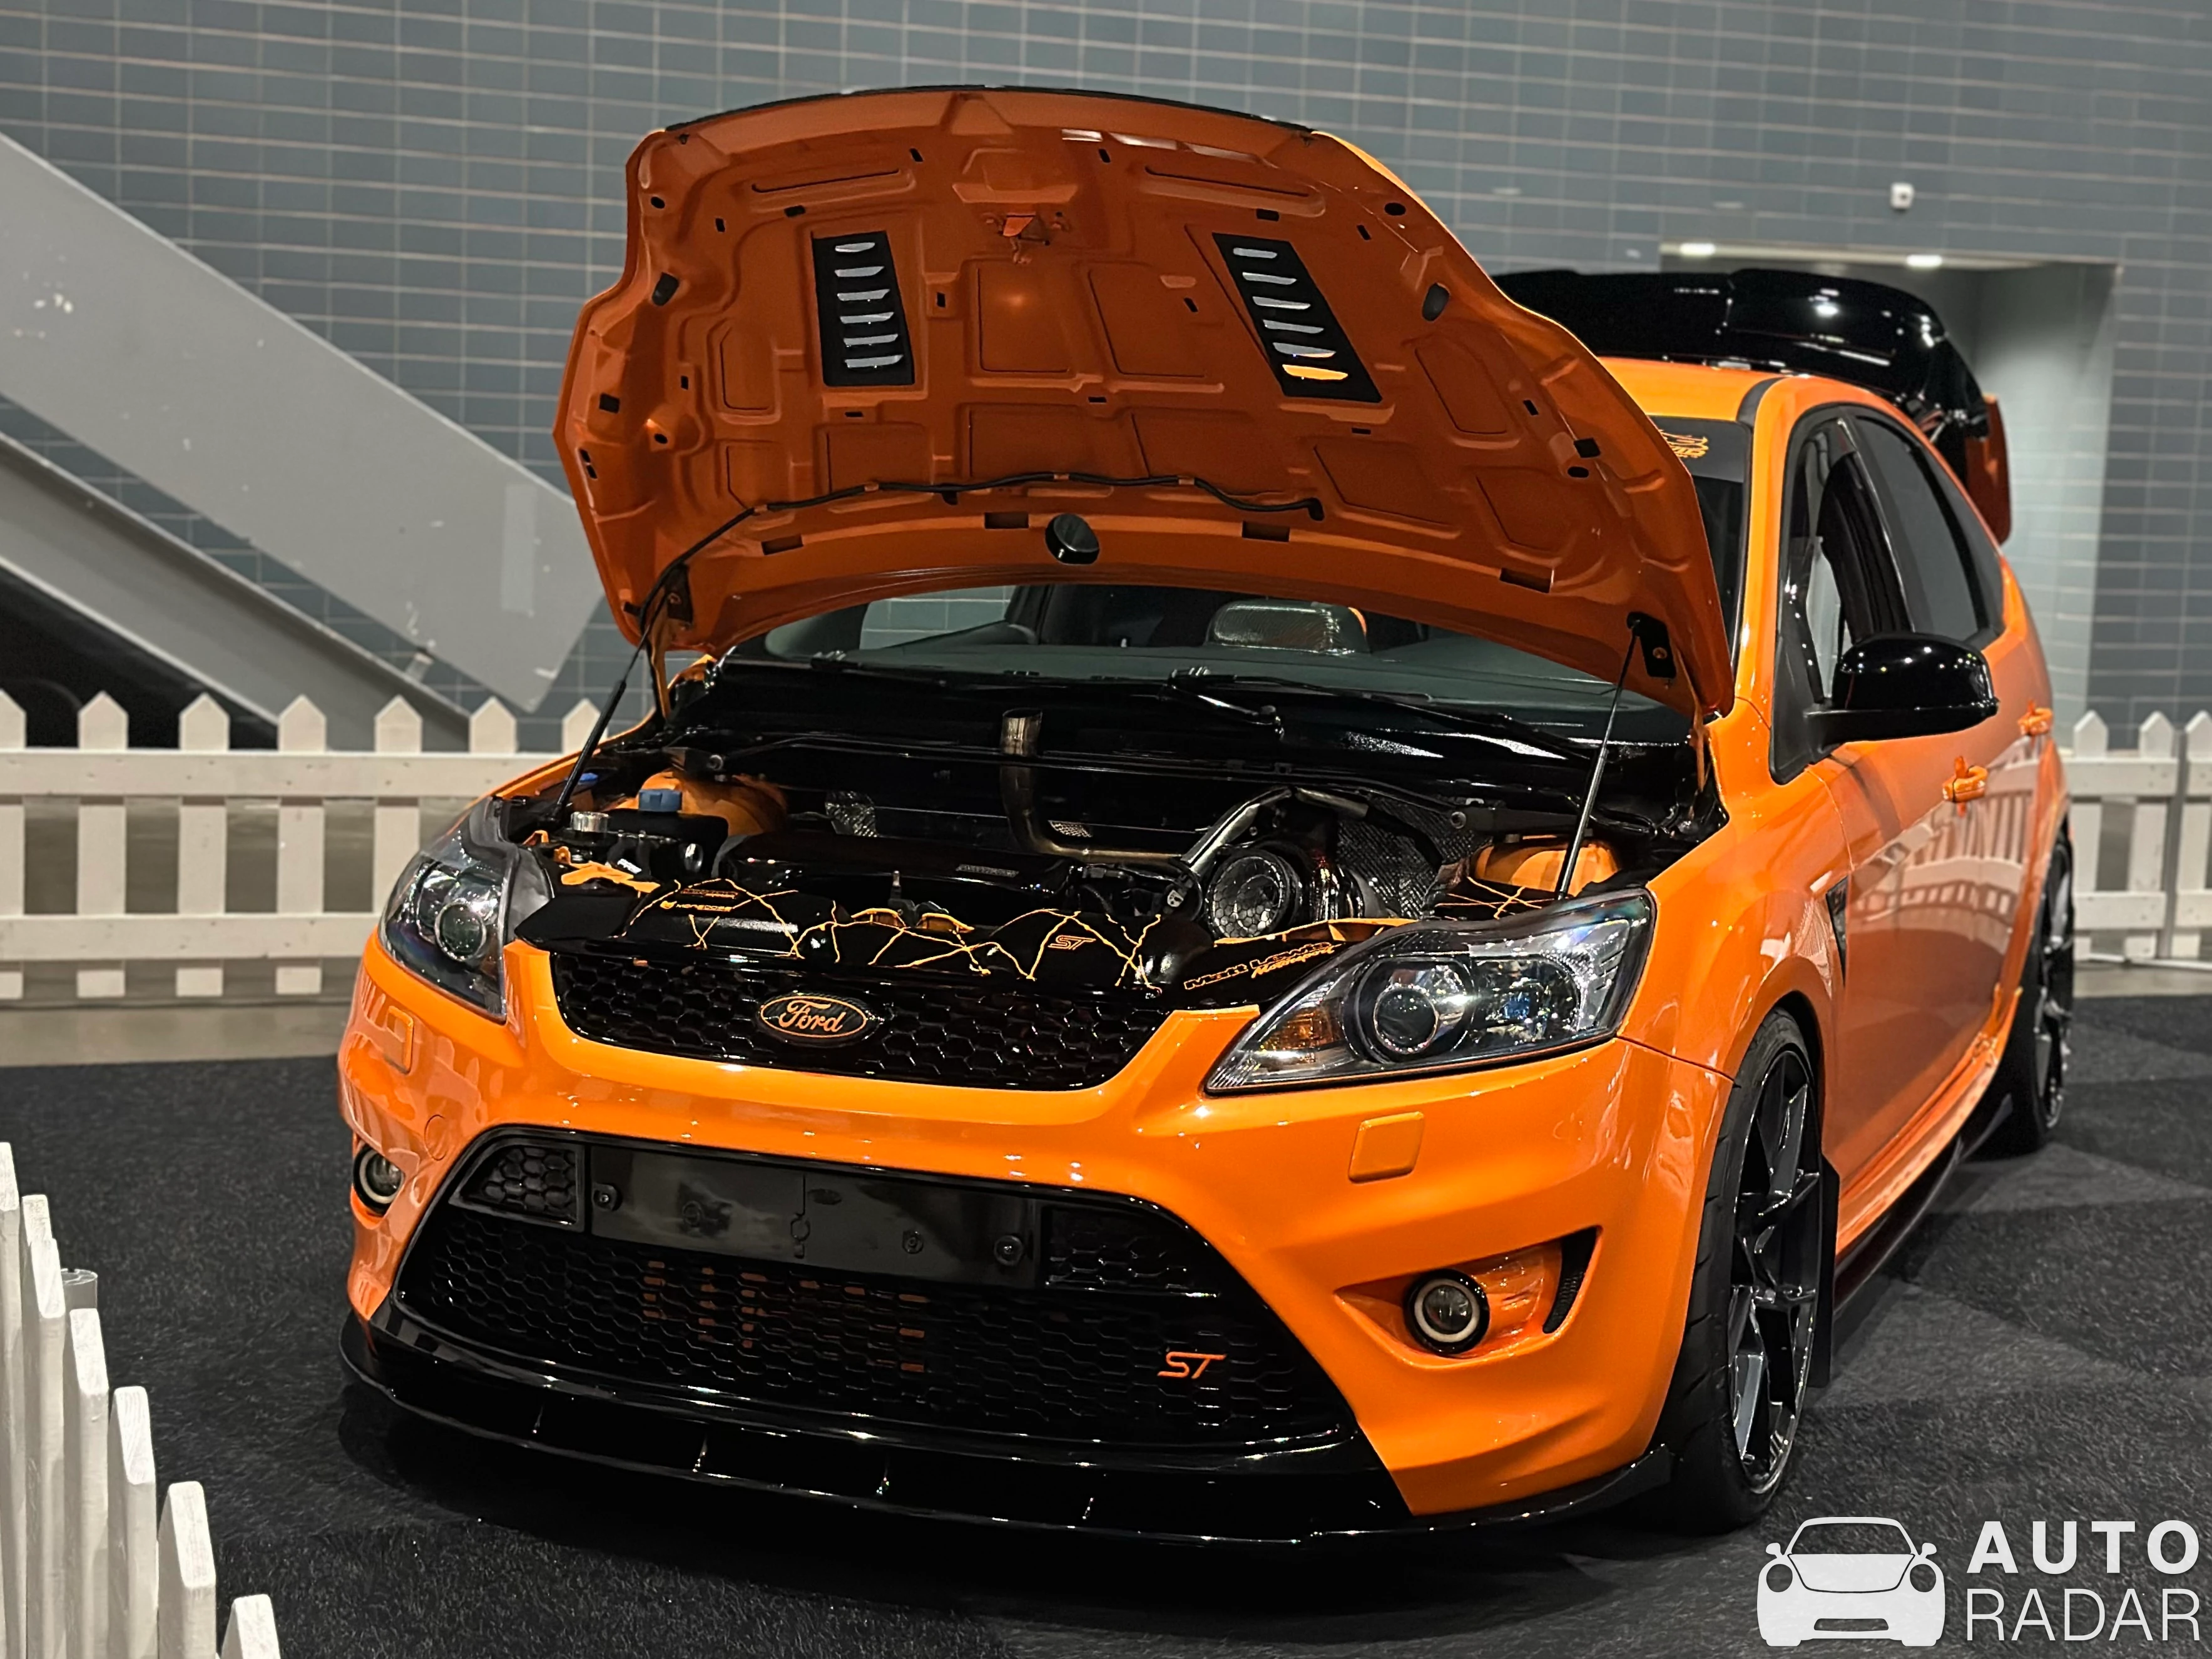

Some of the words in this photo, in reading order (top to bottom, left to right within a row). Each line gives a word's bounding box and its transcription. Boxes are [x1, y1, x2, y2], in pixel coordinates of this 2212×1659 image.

[1047, 935, 1096, 950] ST
[1251, 944, 1342, 978] Motorsport
[1184, 964, 1248, 990] Matt
[778, 1000, 846, 1032] Ford
[1157, 1351, 1227, 1379] ST
